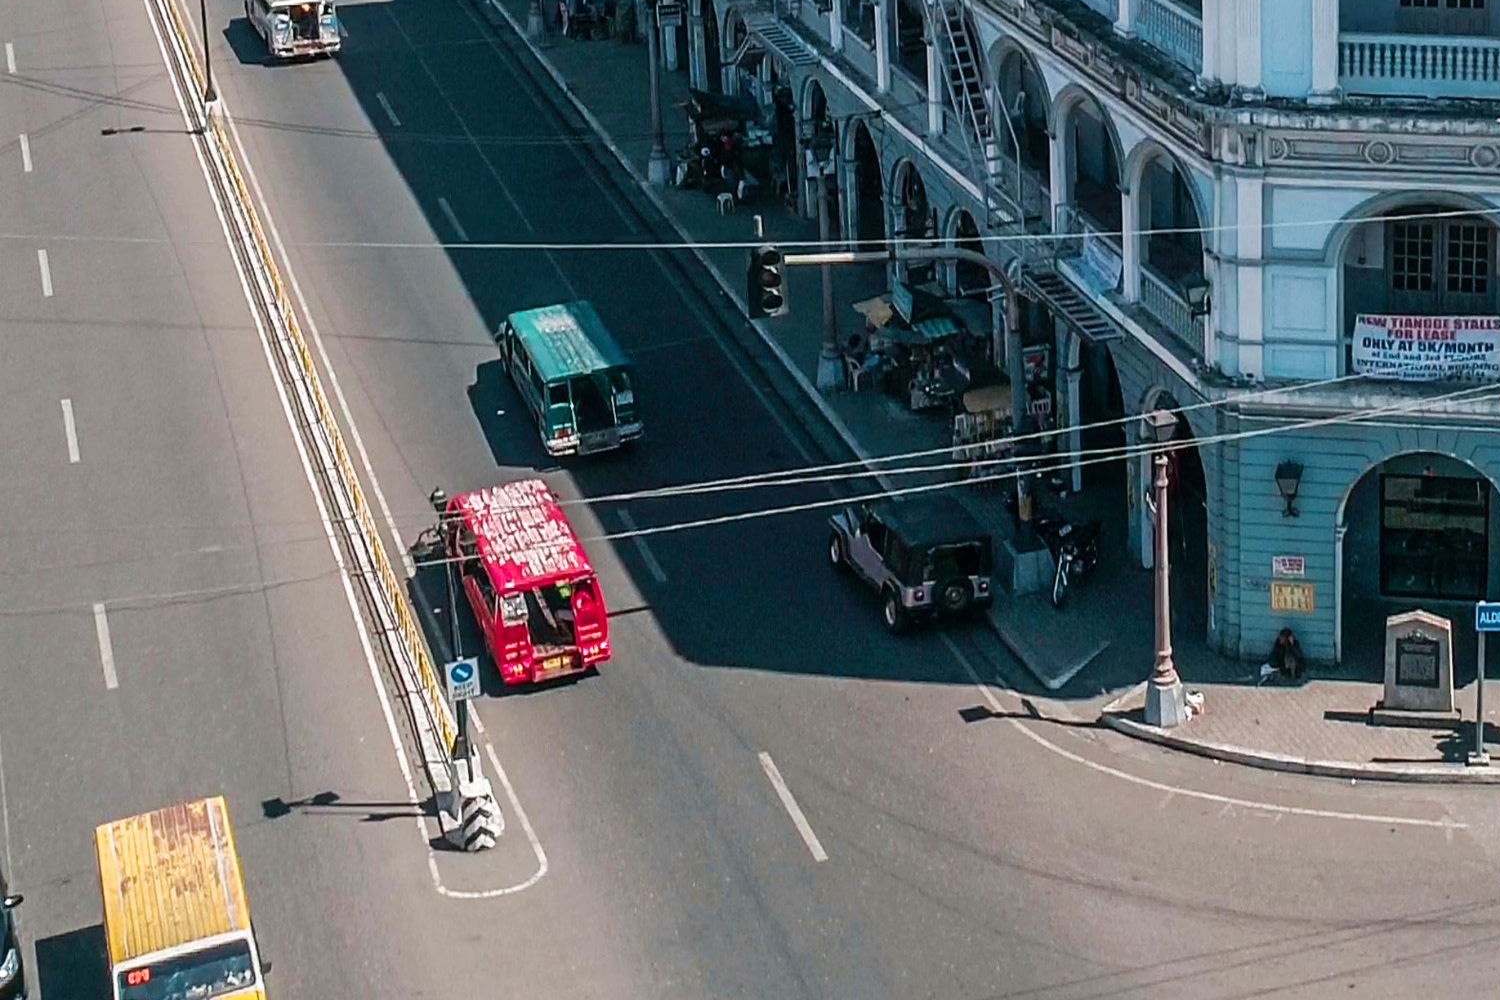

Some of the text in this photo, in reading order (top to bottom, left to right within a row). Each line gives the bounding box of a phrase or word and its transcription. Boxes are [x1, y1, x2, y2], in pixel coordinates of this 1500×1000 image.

[1358, 314, 1387, 328] NEW
[1387, 329, 1457, 341] FOR LEASE
[1362, 337, 1494, 354] ONLY AT 5K/MONTH
